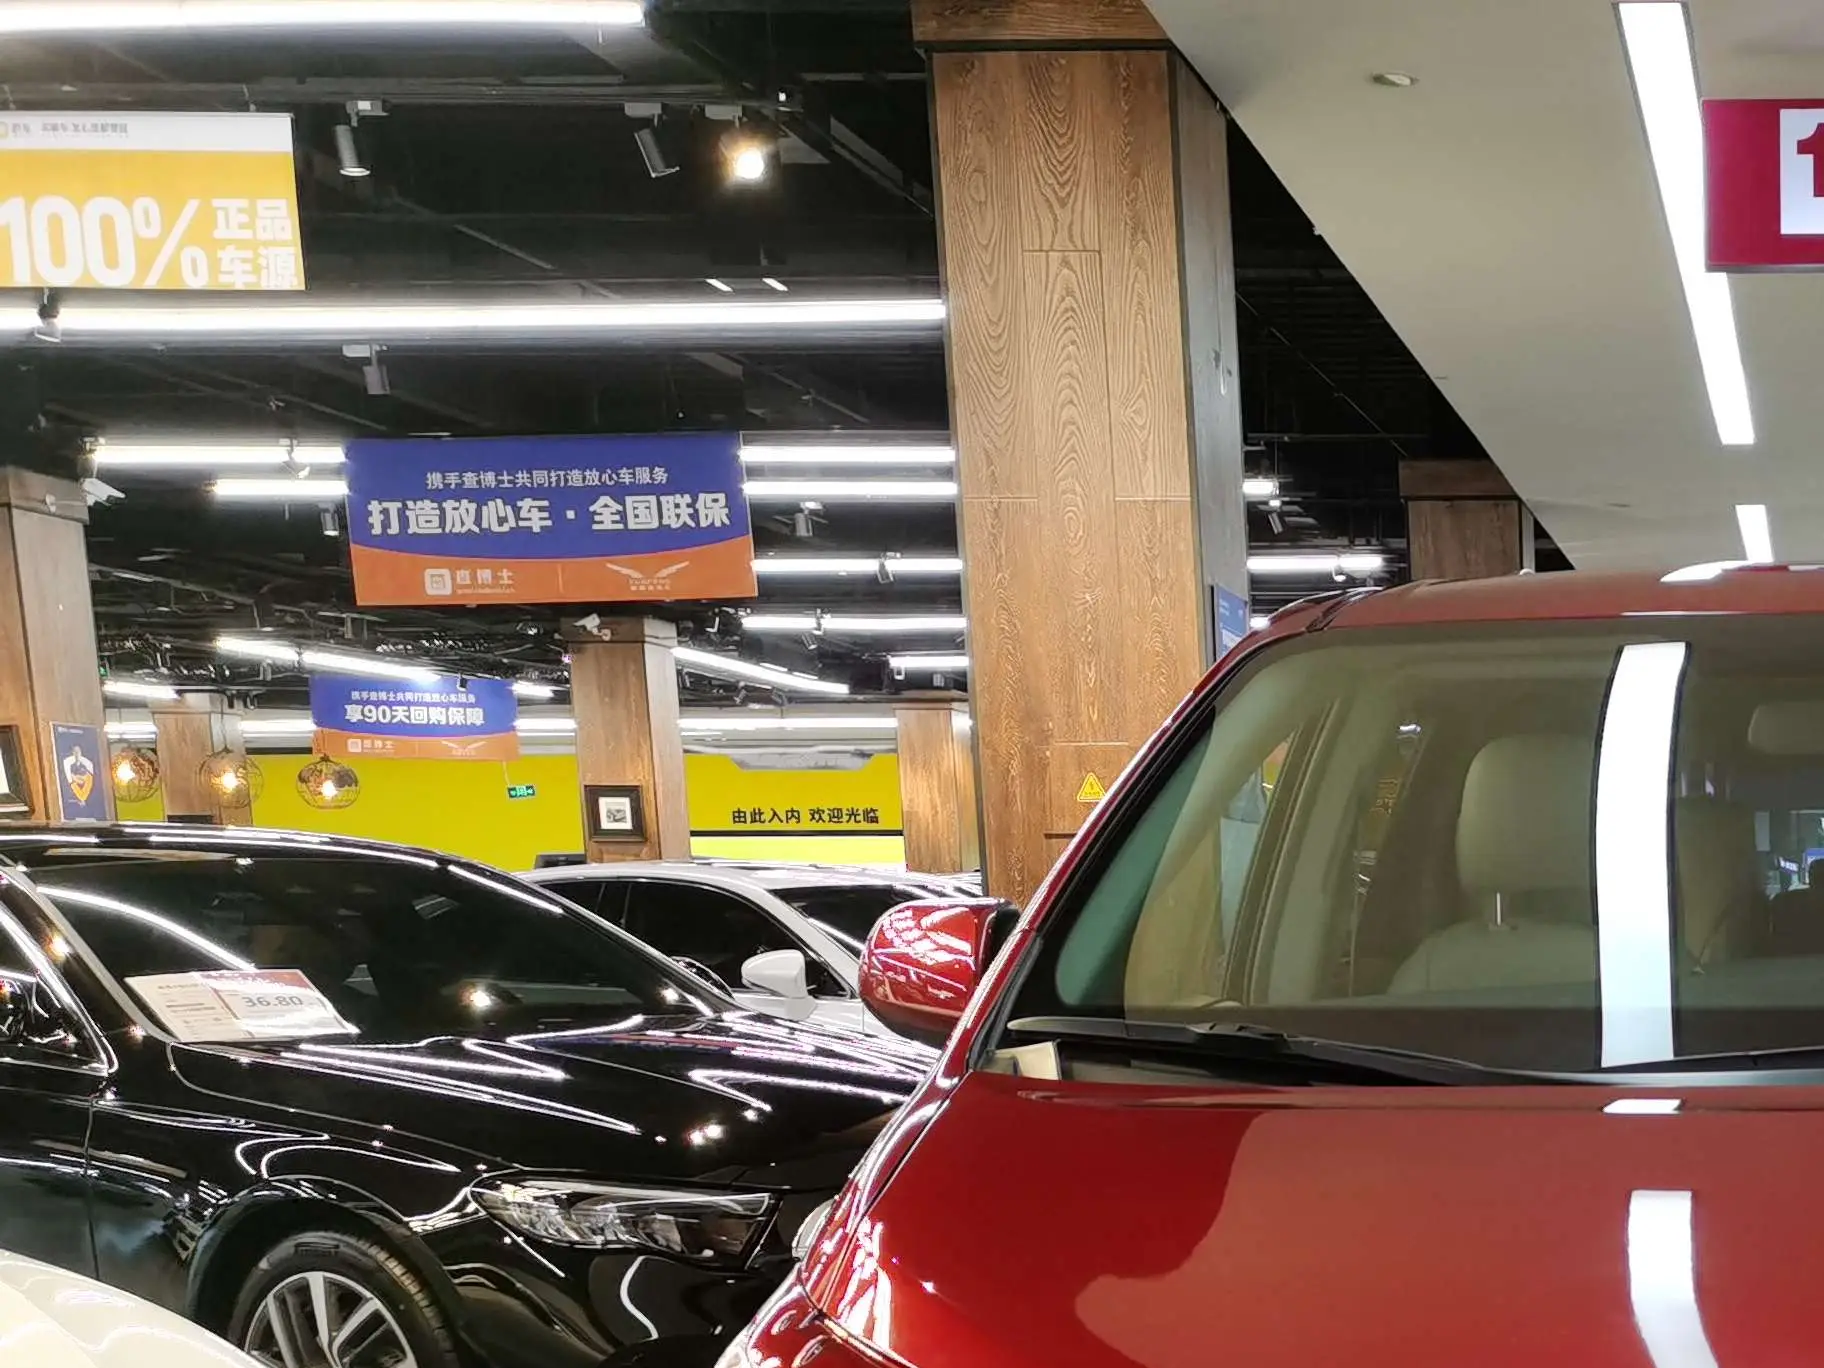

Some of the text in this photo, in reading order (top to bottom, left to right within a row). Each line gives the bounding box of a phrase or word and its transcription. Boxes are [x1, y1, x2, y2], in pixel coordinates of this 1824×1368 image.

[212, 197, 293, 241] 正品
[0, 194, 210, 289] 100%
[216, 245, 299, 290] 车源
[344, 703, 485, 726] 享90天回购保障
[732, 807, 880, 825] 由此入内 欢迎光临
